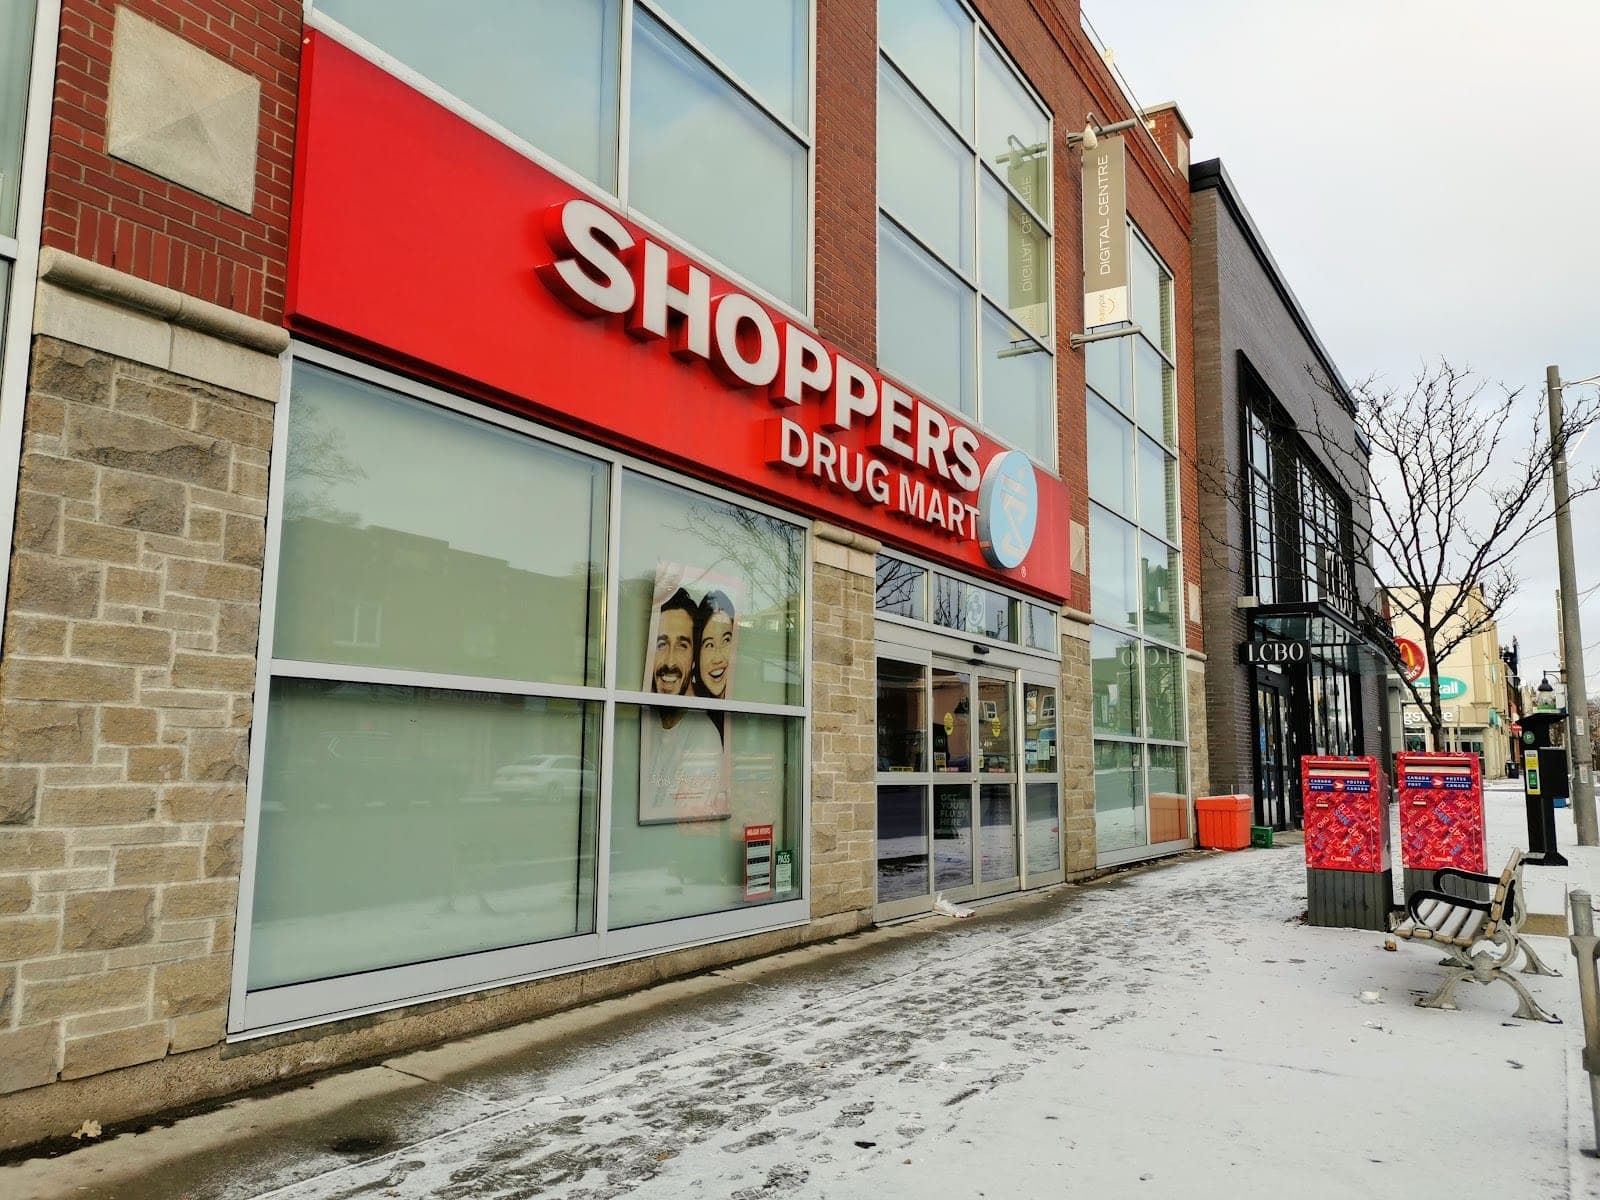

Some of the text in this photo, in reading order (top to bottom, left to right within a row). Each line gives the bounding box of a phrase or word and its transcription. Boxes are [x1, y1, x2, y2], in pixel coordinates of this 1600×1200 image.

[1098, 154, 1111, 275] DIGITAL CENTRE
[555, 199, 981, 493] SHOPPERS
[781, 415, 980, 541] DRUG MART
[1248, 642, 1304, 662] LCBO
[777, 854, 790, 865] PASS
